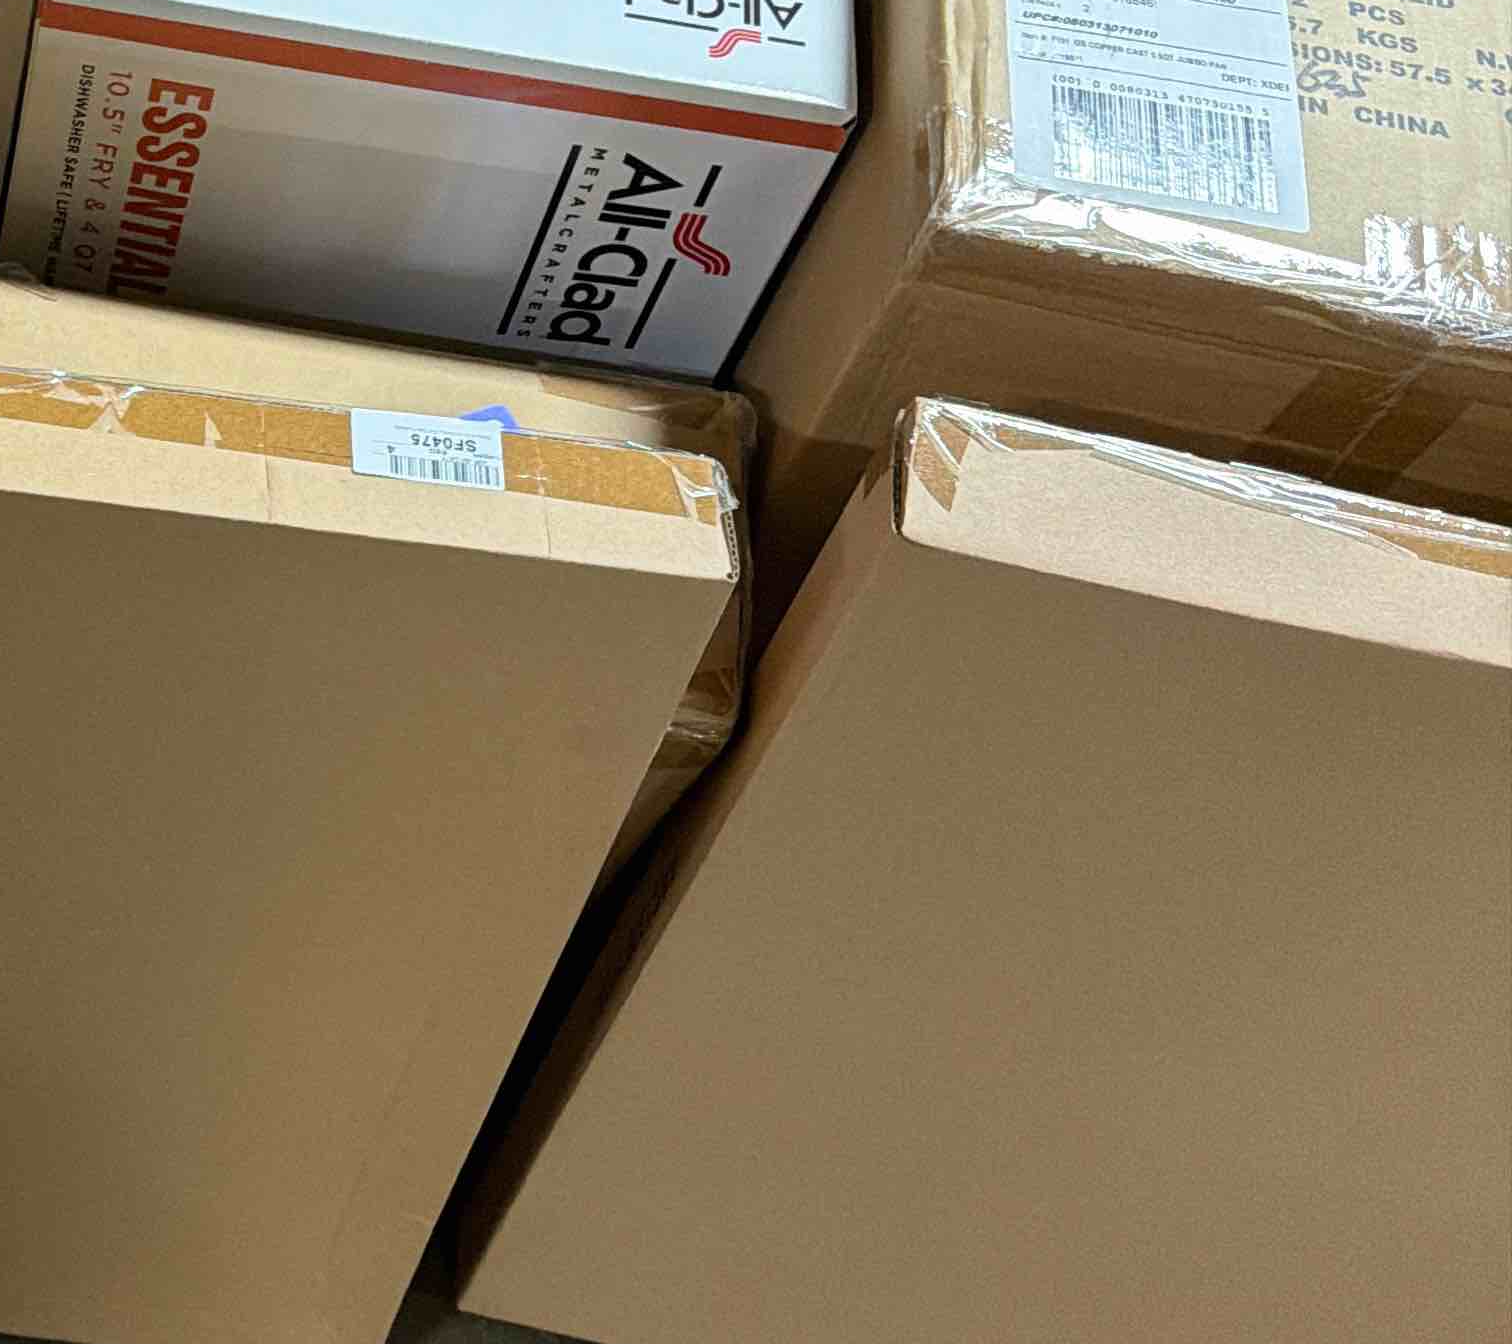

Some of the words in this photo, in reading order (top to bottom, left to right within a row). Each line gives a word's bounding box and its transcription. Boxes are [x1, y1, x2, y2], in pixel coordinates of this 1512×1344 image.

[1348, 1, 1406, 26] PCS
[1357, 27, 1418, 54] KGS
[1390, 60, 1452, 85] 57.5
[65, 64, 96, 154] DISHWASHER
[102, 71, 133, 135] 10.5"
[1298, 95, 1330, 115] IN
[1353, 105, 1451, 139] CHINA
[59, 156, 79, 191] SAFE
[89, 142, 120, 191] FRY
[84, 197, 105, 212] &
[517, 147, 608, 337] METALCRAFTERS
[545, 153, 684, 346] All-Clad
[410, 433, 477, 453] SF0475
